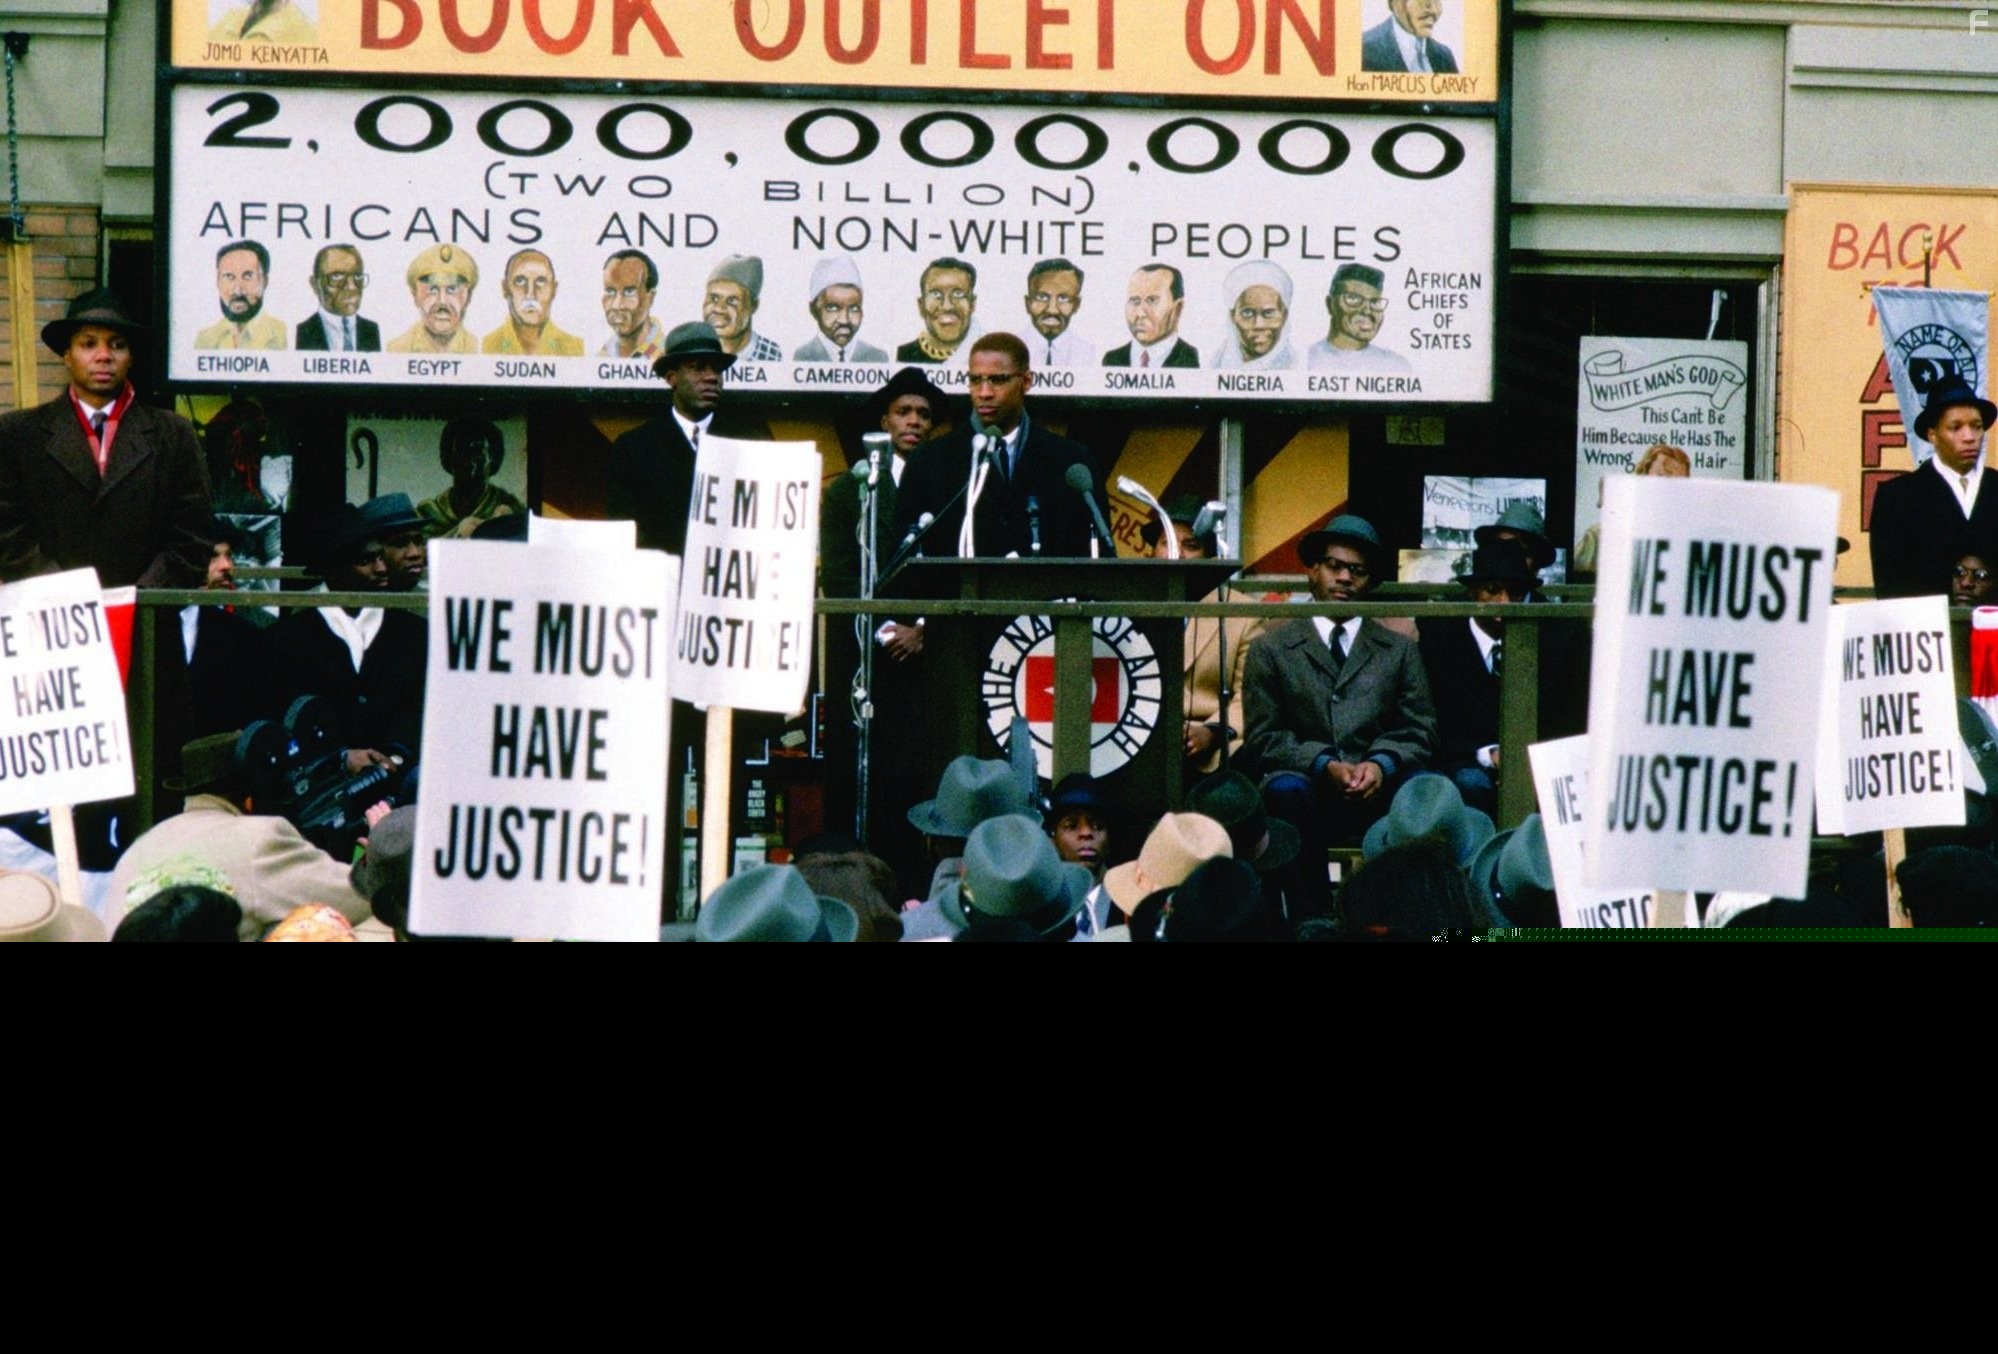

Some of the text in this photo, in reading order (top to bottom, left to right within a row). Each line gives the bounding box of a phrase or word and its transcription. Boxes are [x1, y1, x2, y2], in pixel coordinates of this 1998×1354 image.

[1184, 0, 1336, 76] ON
[202, 43, 329, 64] JOMO KENYATTA
[1371, 74, 1426, 94] MARCUS
[1430, 72, 1479, 95] GARVEY
[484, 160, 1096, 216] (TWO BILLION)
[199, 200, 1403, 262] AFRICANS AND NON-WHITE PEOPLES
[1828, 222, 1966, 271] BACK
[1403, 267, 1482, 291] AFRICAN
[1407, 290, 1469, 312] CHIEFS
[1433, 312, 1454, 329] OF
[1409, 327, 1472, 351] STATES
[1898, 326, 1944, 355] NAME
[197, 356, 270, 374] ETHIOPIA
[303, 358, 371, 375] LIBERIA
[407, 360, 461, 377] EGYPT
[494, 360, 556, 379] SUDAN
[725, 366, 767, 383] INEA
[794, 367, 890, 384] CAMEROON
[1104, 373, 1175, 390] SOMALIA
[1217, 374, 1284, 392] NIGERIA
[1308, 376, 1422, 393] EAST NIGERIA
[1594, 363, 1719, 402] WHITE MAN'S GOD
[1641, 406, 1669, 424] This
[1708, 409, 1726, 425] Be
[1582, 427, 1736, 448] Him Because He Has The
[1584, 449, 1636, 473] Wrong
[1628, 538, 1823, 624] WE MUST
[446, 596, 659, 679] WE MUST
[1843, 630, 1945, 683] WE MUST
[13, 666, 86, 718] HAVE
[1645, 648, 1755, 729] HAVE
[982, 655, 1018, 712] THE
[1109, 655, 1161, 760] ALLAH
[1861, 692, 1923, 740] HAVE
[490, 704, 609, 783] HAVE
[1844, 749, 1956, 802] JUSTICE!
[1608, 754, 1798, 837] JUSTICE!
[434, 802, 648, 888] JUSTICE!
